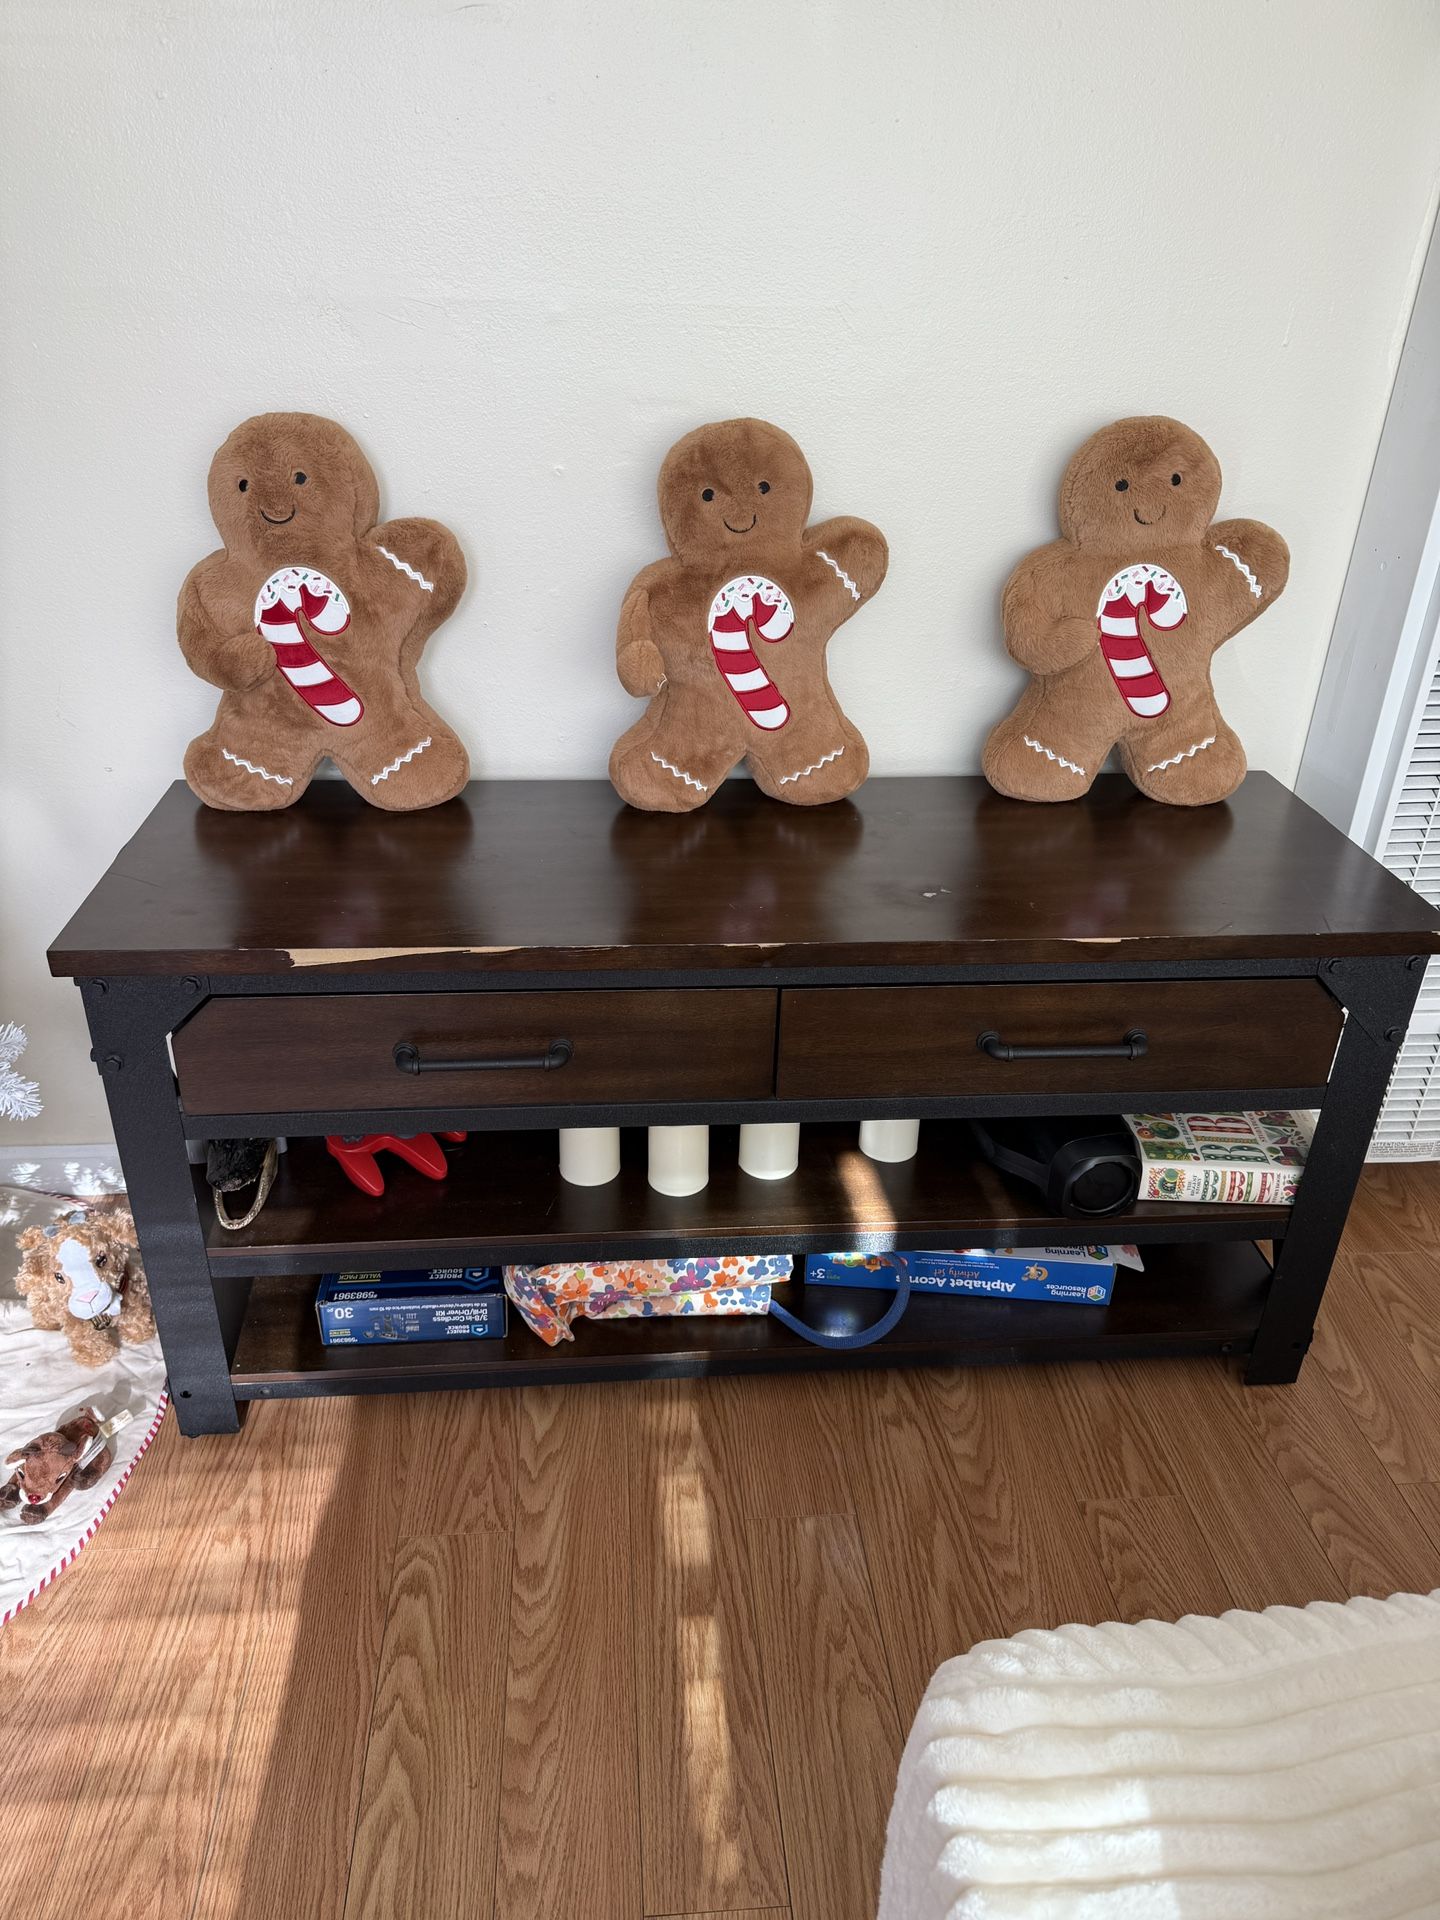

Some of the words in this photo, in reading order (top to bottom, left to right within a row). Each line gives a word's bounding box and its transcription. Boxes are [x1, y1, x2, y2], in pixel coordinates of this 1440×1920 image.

[1201, 1169, 1275, 1203] BIBLE
[1045, 1248, 1086, 1257] Learning
[810, 1268, 826, 1279] 3+
[934, 1268, 946, 1276] Set
[949, 1267, 980, 1279] Activity
[949, 1277, 1016, 1292] Alphabet
[1045, 1283, 1087, 1292] Resources
[333, 1291, 378, 1301] #5983961
[1051, 1289, 1086, 1299] Learning
[334, 1307, 354, 1319] 30
[446, 1308, 488, 1316] Drill/Driver
